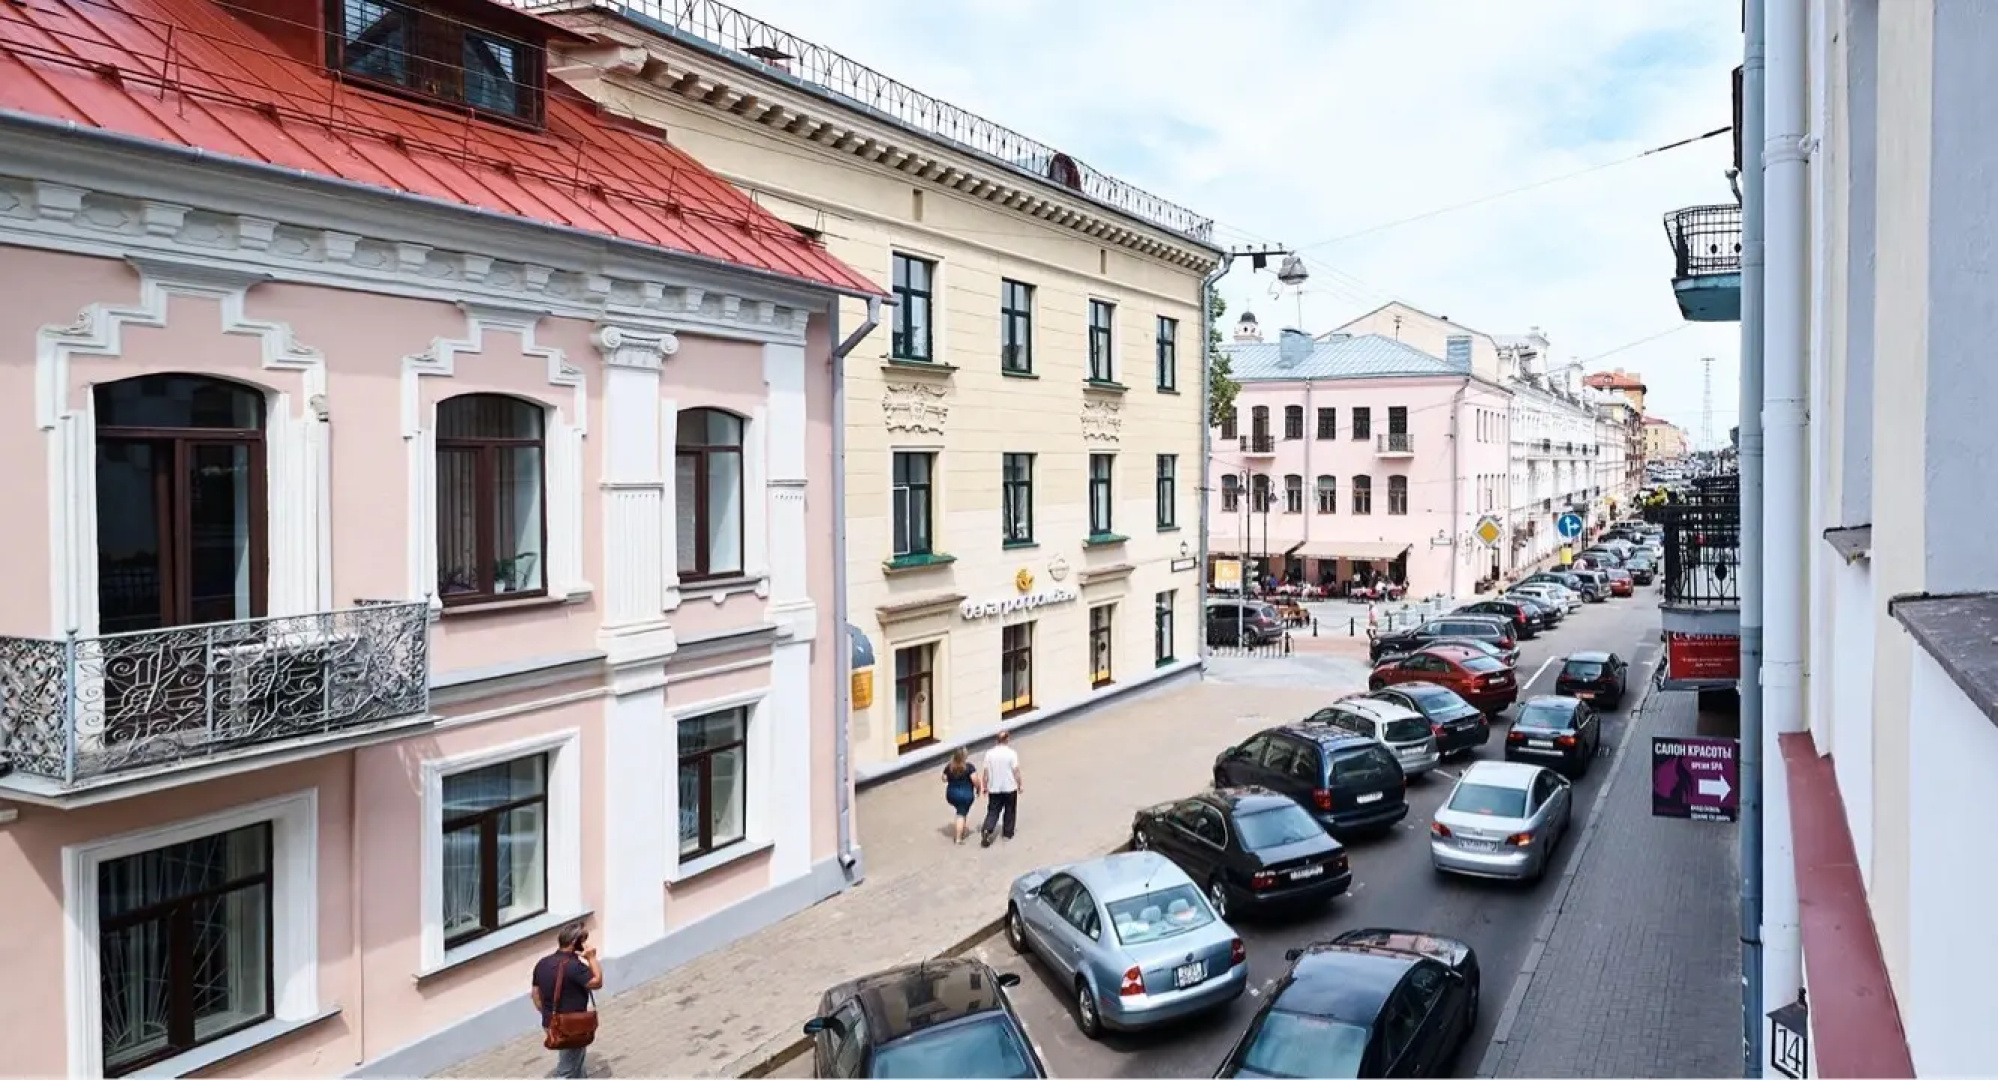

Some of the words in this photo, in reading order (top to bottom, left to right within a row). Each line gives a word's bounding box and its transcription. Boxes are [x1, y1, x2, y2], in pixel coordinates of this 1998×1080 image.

[1655, 742, 1686, 756] САЛОН
[1688, 744, 1732, 759] КРАСОТЫ
[1778, 1028, 1802, 1072] 14
